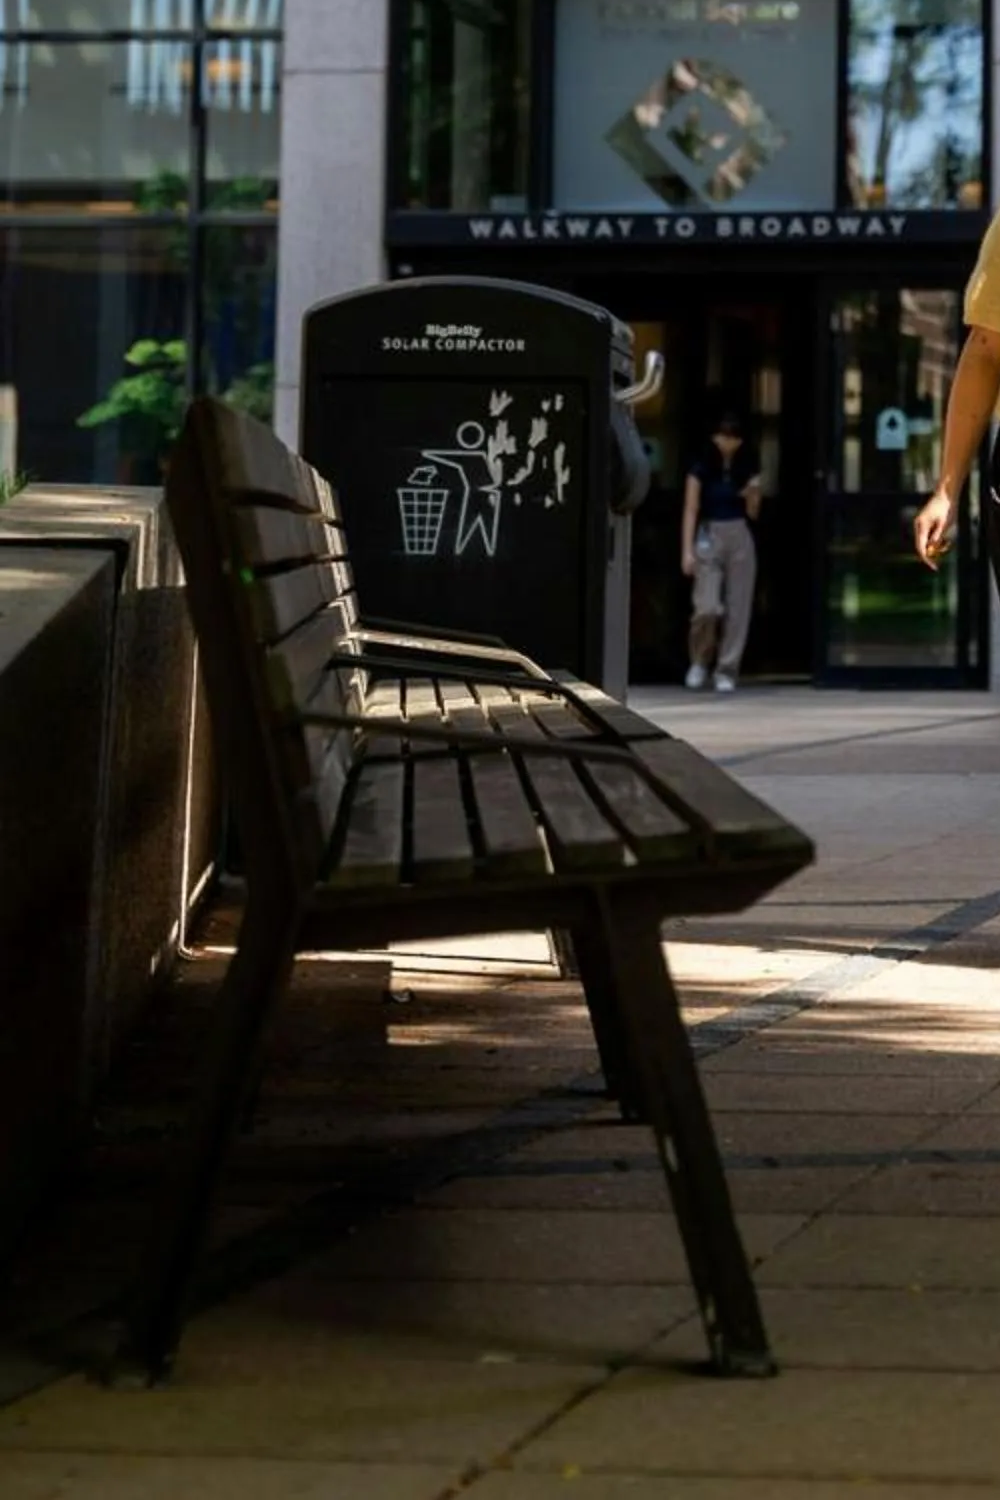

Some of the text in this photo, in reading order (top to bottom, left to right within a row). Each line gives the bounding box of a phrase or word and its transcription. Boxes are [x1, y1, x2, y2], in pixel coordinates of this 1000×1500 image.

[469, 215, 908, 239] WALKWAY TO BROADWAY
[382, 337, 526, 352] SOLAR COMPACTOR
